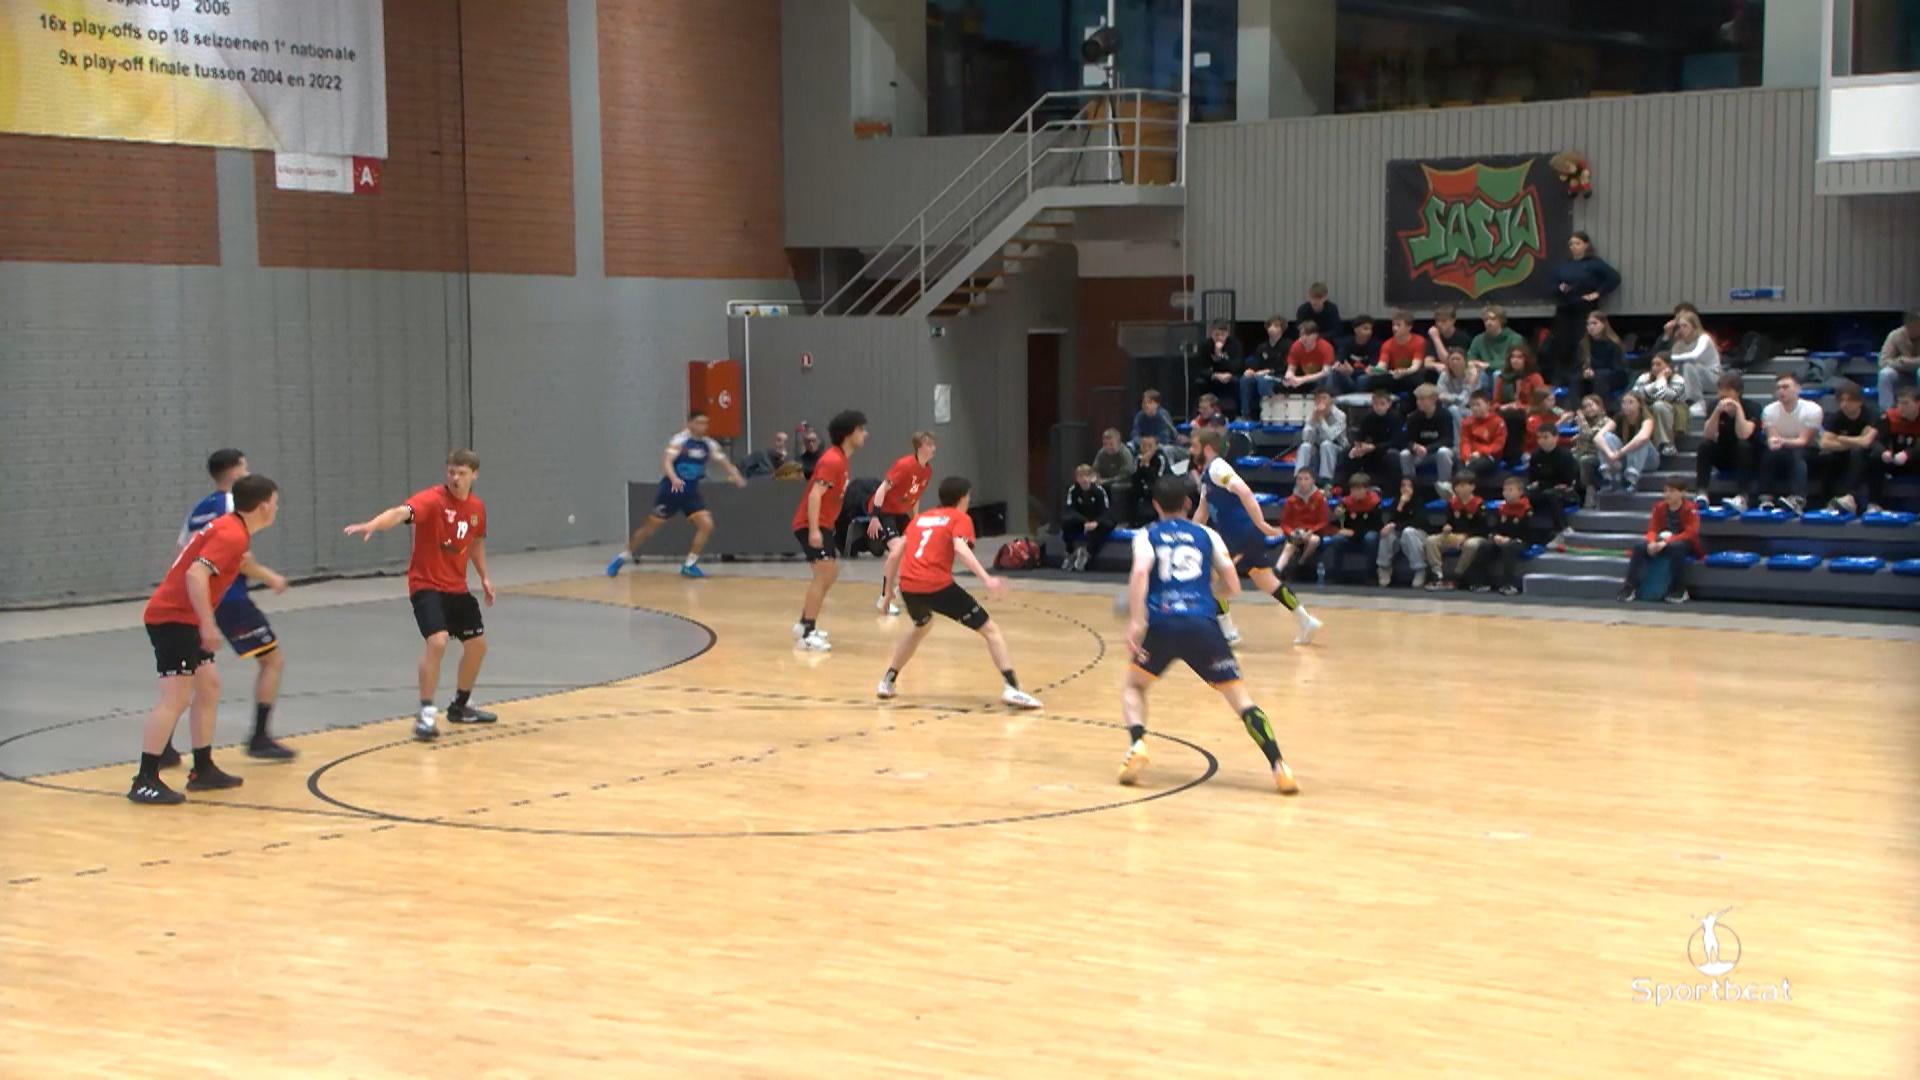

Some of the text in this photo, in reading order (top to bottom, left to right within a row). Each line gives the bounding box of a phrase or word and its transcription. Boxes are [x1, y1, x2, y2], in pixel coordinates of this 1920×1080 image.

[39, 14, 66, 32] 16x
[73, 18, 143, 40] play-offs
[147, 28, 168, 44] op
[173, 28, 189, 44] 18
[193, 33, 269, 51] seizoenen
[290, 43, 356, 62] nationale
[59, 48, 78, 66] 9x
[83, 53, 144, 74] play-off
[149, 56, 190, 76] finale
[250, 67, 283, 84] 2004
[287, 73, 305, 87] en
[309, 73, 343, 91] 2022
[360, 165, 375, 187] A
[456, 521, 469, 540] 19
